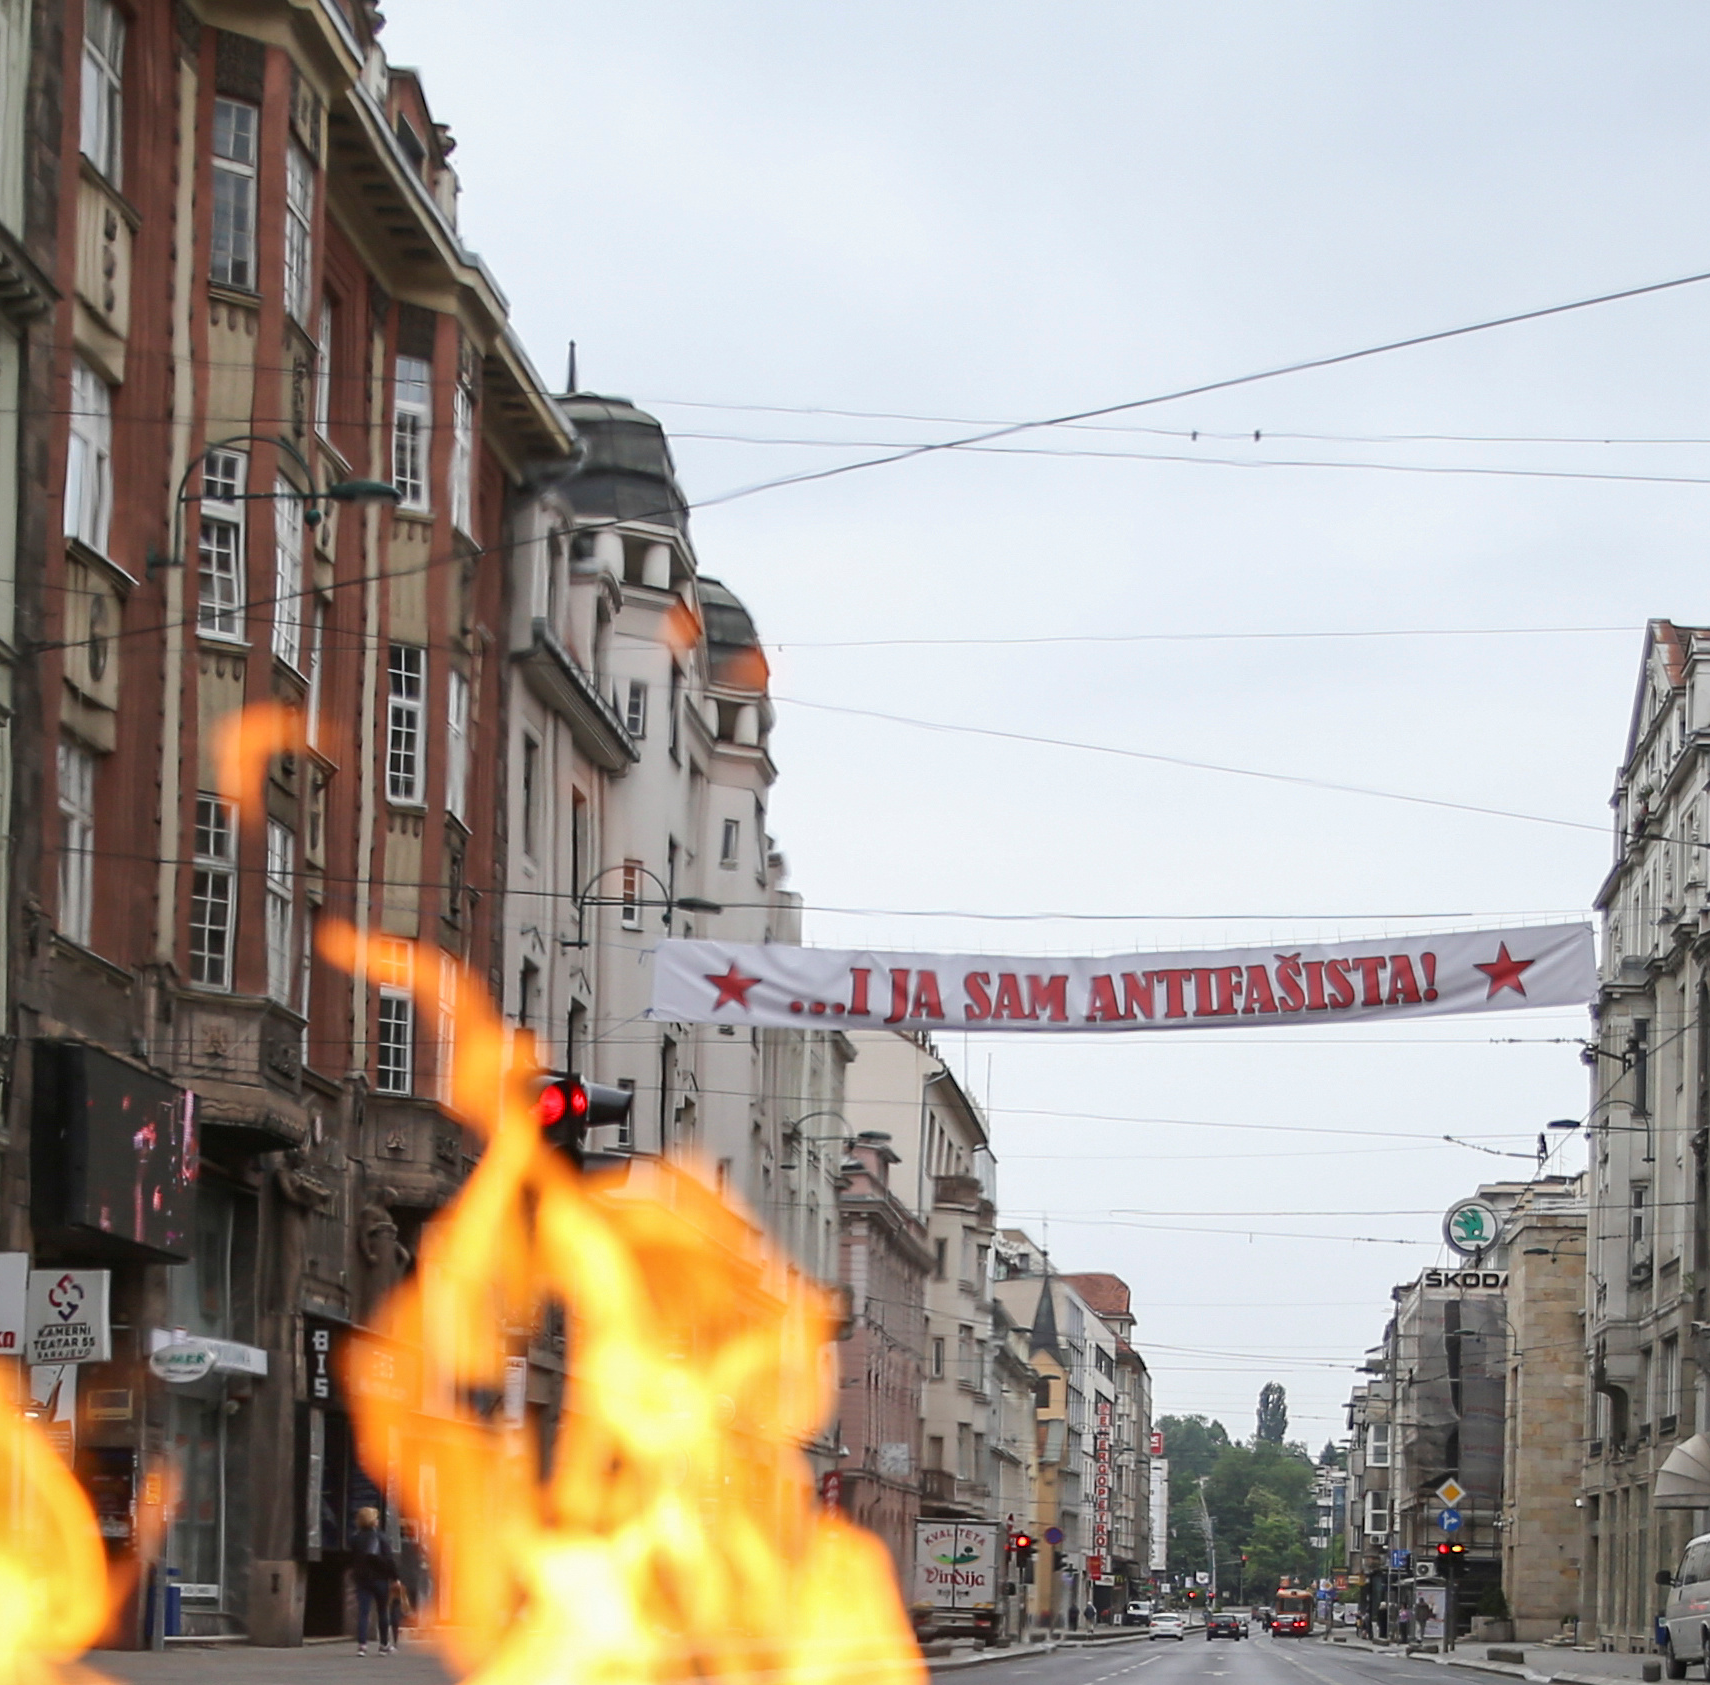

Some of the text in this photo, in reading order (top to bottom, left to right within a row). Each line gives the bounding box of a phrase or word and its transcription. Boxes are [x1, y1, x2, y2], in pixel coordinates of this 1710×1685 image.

[883, 967, 945, 1024] JA
[963, 970, 1069, 1022] SAM
[1085, 950, 1438, 1023] ANTIFAŠISTA!
[38, 1326, 92, 1338] KAMERNI
[33, 1335, 96, 1351] TEATAR 55
[37, 1348, 92, 1360] SARAJEVO
[312, 1329, 330, 1399] BIS
[923, 1528, 986, 1547] KVALTETA
[923, 1566, 986, 1589] Vindija
